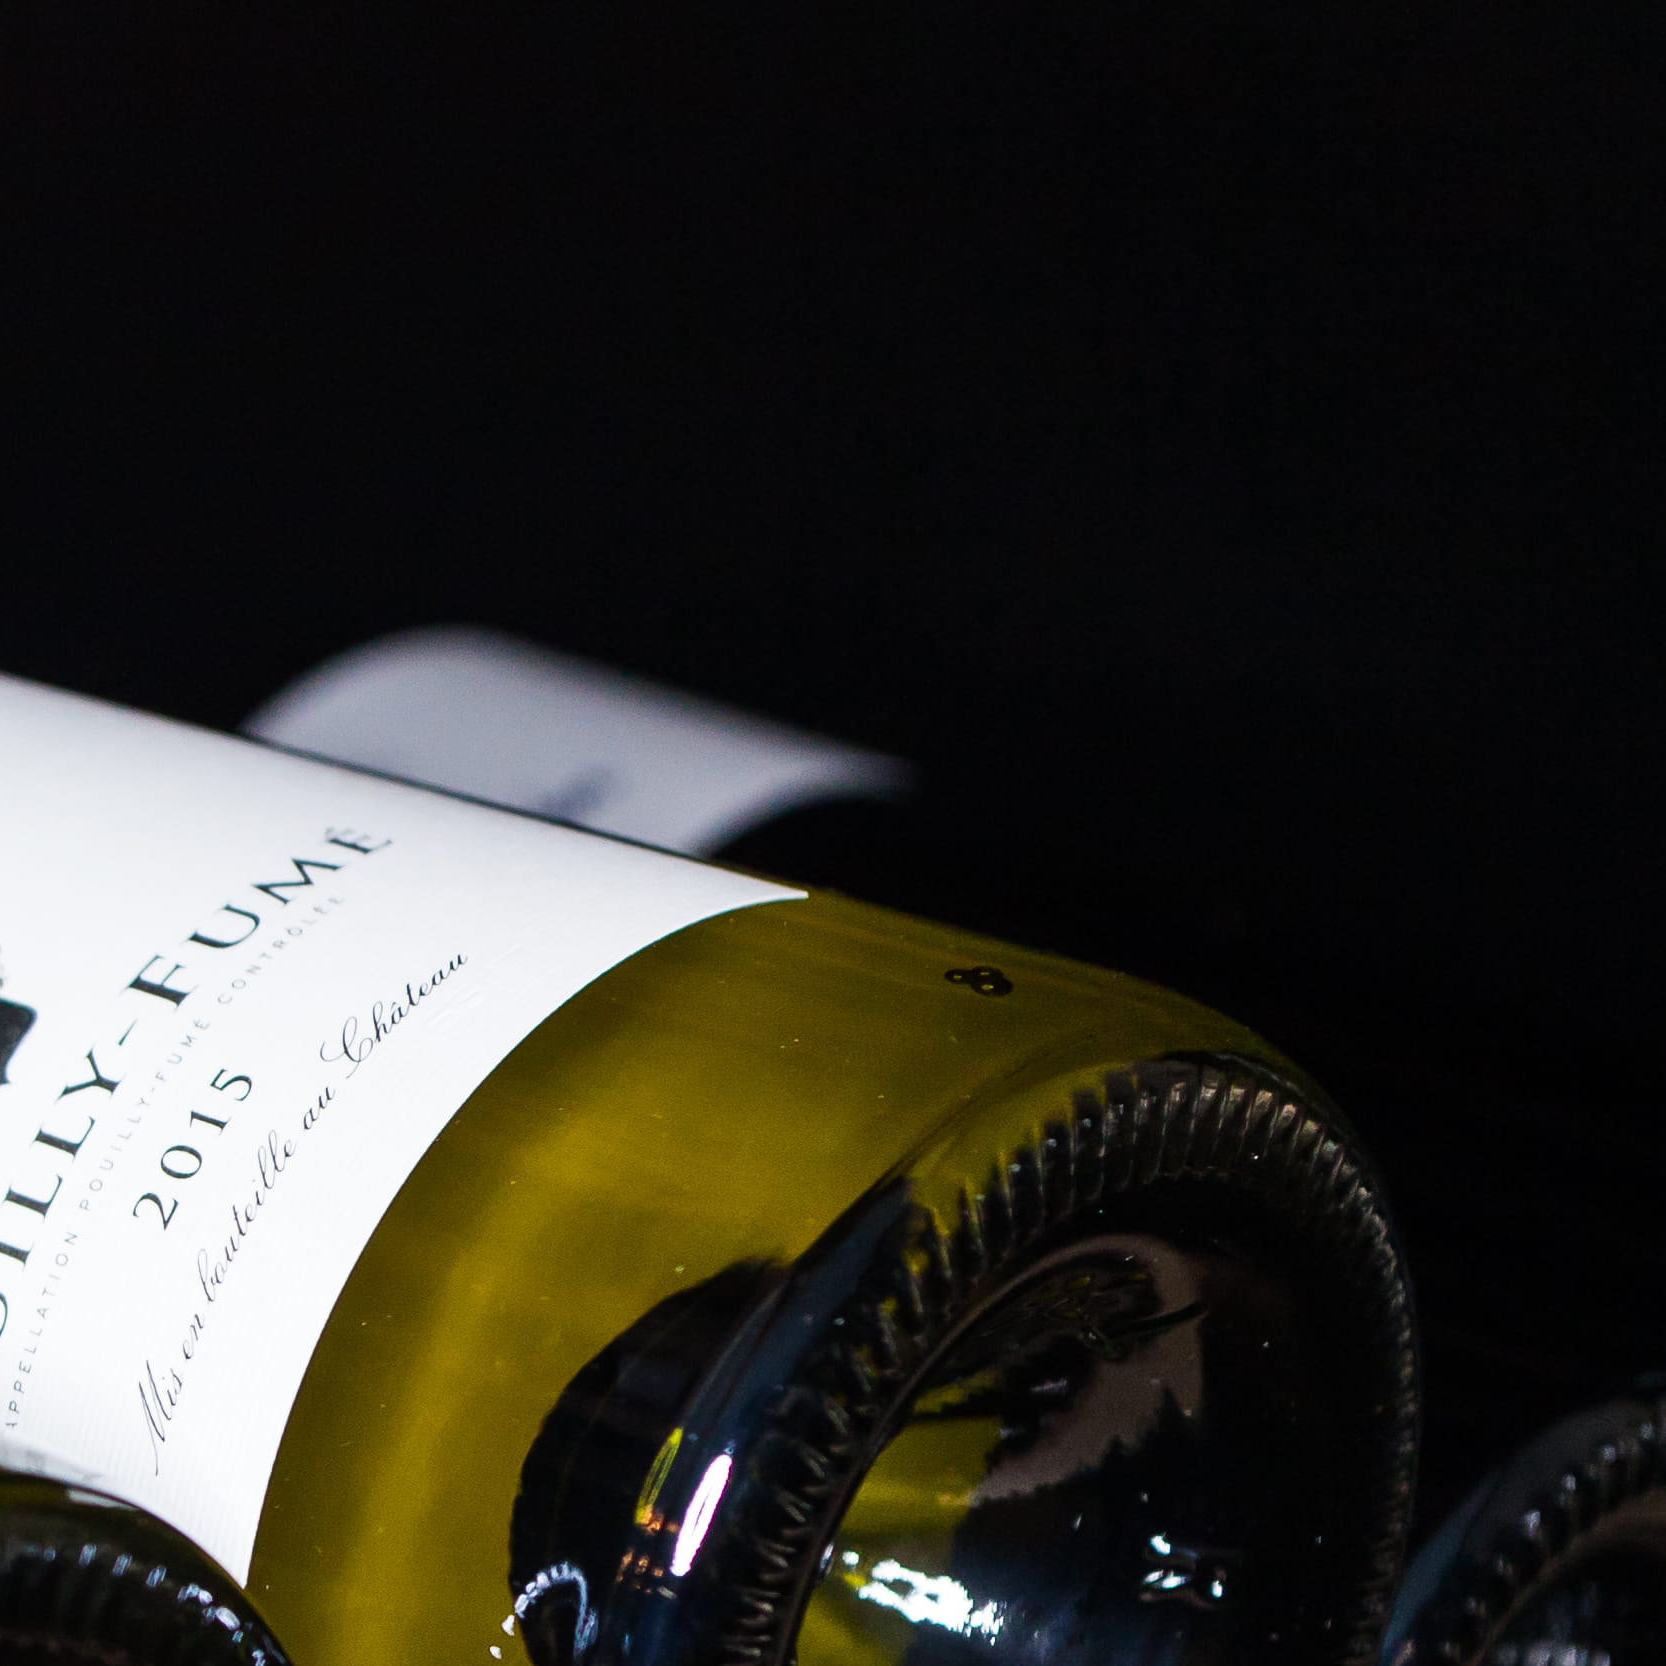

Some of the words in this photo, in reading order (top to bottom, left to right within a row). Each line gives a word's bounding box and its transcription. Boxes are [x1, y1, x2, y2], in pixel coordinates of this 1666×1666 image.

[132, 1068, 253, 1231] 2015
[138, 1359, 183, 1477] Mis
[182, 1313, 205, 1360] en
[197, 1129, 296, 1303] bouteille
[302, 1085, 335, 1131] au
[319, 953, 468, 1080] Château
